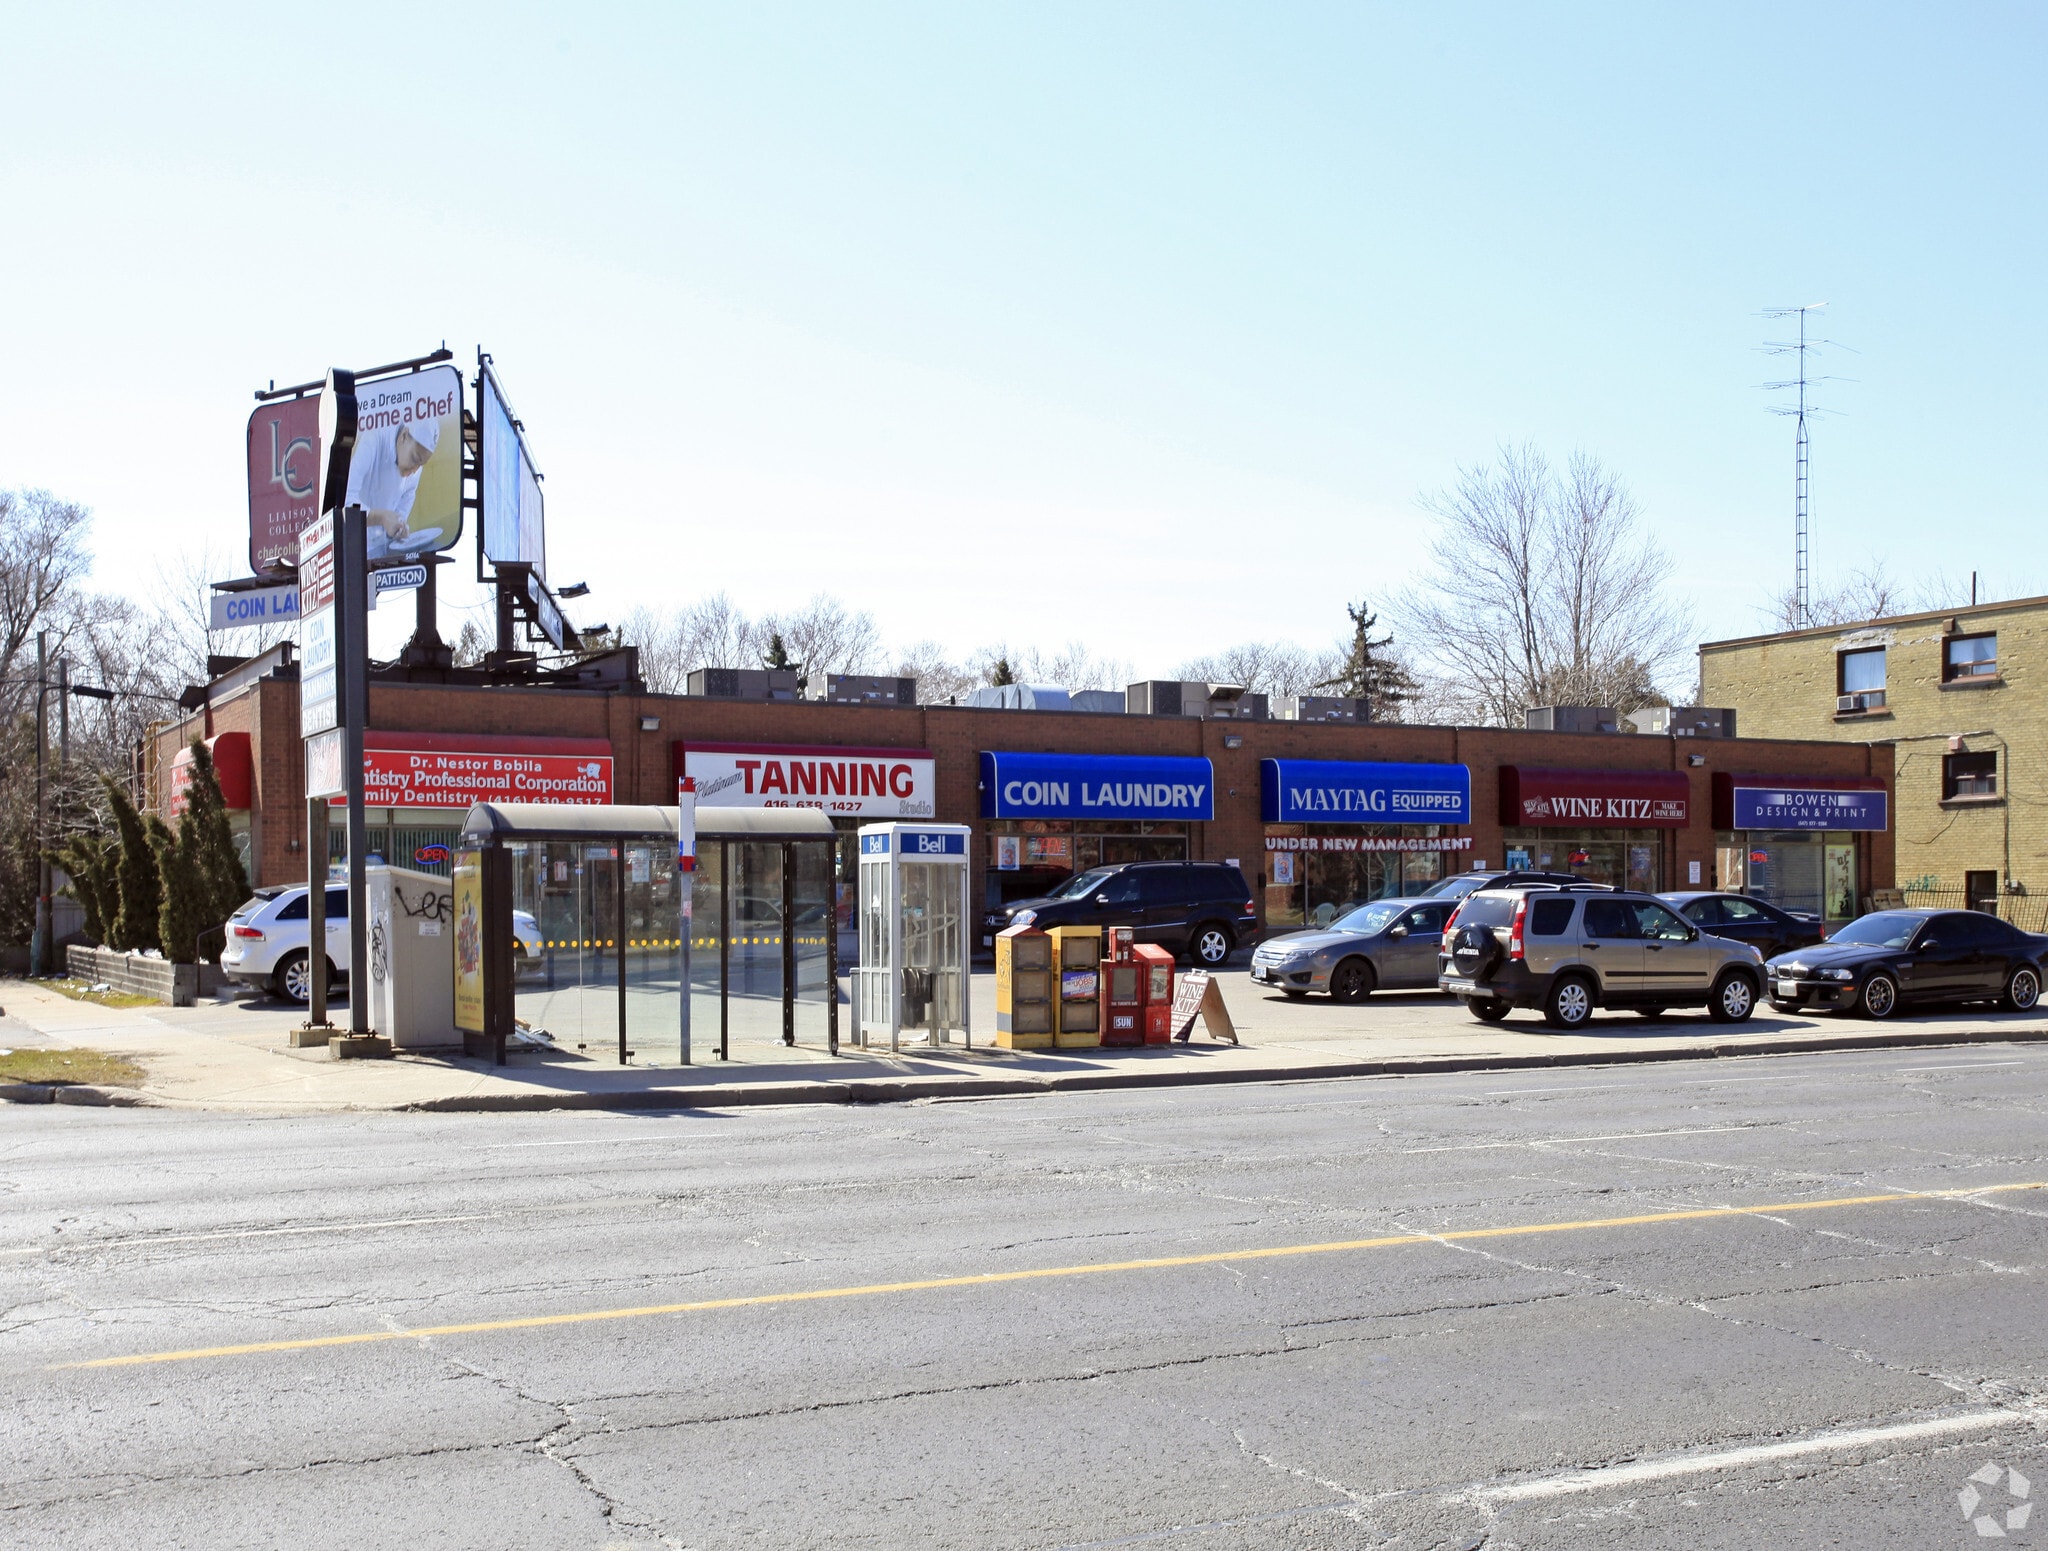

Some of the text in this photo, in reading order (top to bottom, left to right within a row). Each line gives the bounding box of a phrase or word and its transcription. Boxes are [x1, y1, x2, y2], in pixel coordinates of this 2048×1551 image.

[370, 397, 376, 409] a
[378, 391, 412, 407] Dream
[403, 406, 413, 423] a
[415, 391, 453, 420] Chef
[268, 507, 315, 523] LIAISON
[376, 570, 422, 587] PATTISON
[227, 597, 266, 621] COIN
[310, 617, 325, 642] COIN
[303, 640, 332, 669] LAUNDRY
[303, 673, 335, 701] TANNING
[302, 701, 335, 734] DENTIST
[410, 755, 542, 772] Dr. Nestor Bobila
[414, 770, 511, 789] Professional
[514, 773, 606, 793] Corporation
[735, 760, 914, 798] TANNING
[404, 789, 478, 803] Dentistry
[488, 795, 527, 804] (416)
[1004, 781, 1205, 808] COIN LAUNDRY
[1289, 788, 1461, 812] MAYTAG EQUIPPED
[1786, 793, 1838, 807] BOWEN
[899, 800, 932, 815] Studio
[1550, 797, 1652, 819] WINE KITZ
[1661, 802, 1678, 810] MAKE
[1756, 805, 1868, 818] DESIGN & PRINT
[869, 835, 884, 853] Bell
[918, 834, 946, 853] Bell
[1265, 837, 1473, 851] UNDER NEW MANAGEMENT
[414, 848, 450, 860] OPEN
[1279, 860, 1289, 876] 3
[1074, 976, 1094, 987] JOBS
[1179, 982, 1205, 999] WINE
[1174, 997, 1200, 1013] KITZ
[1117, 1017, 1132, 1027] SUN
